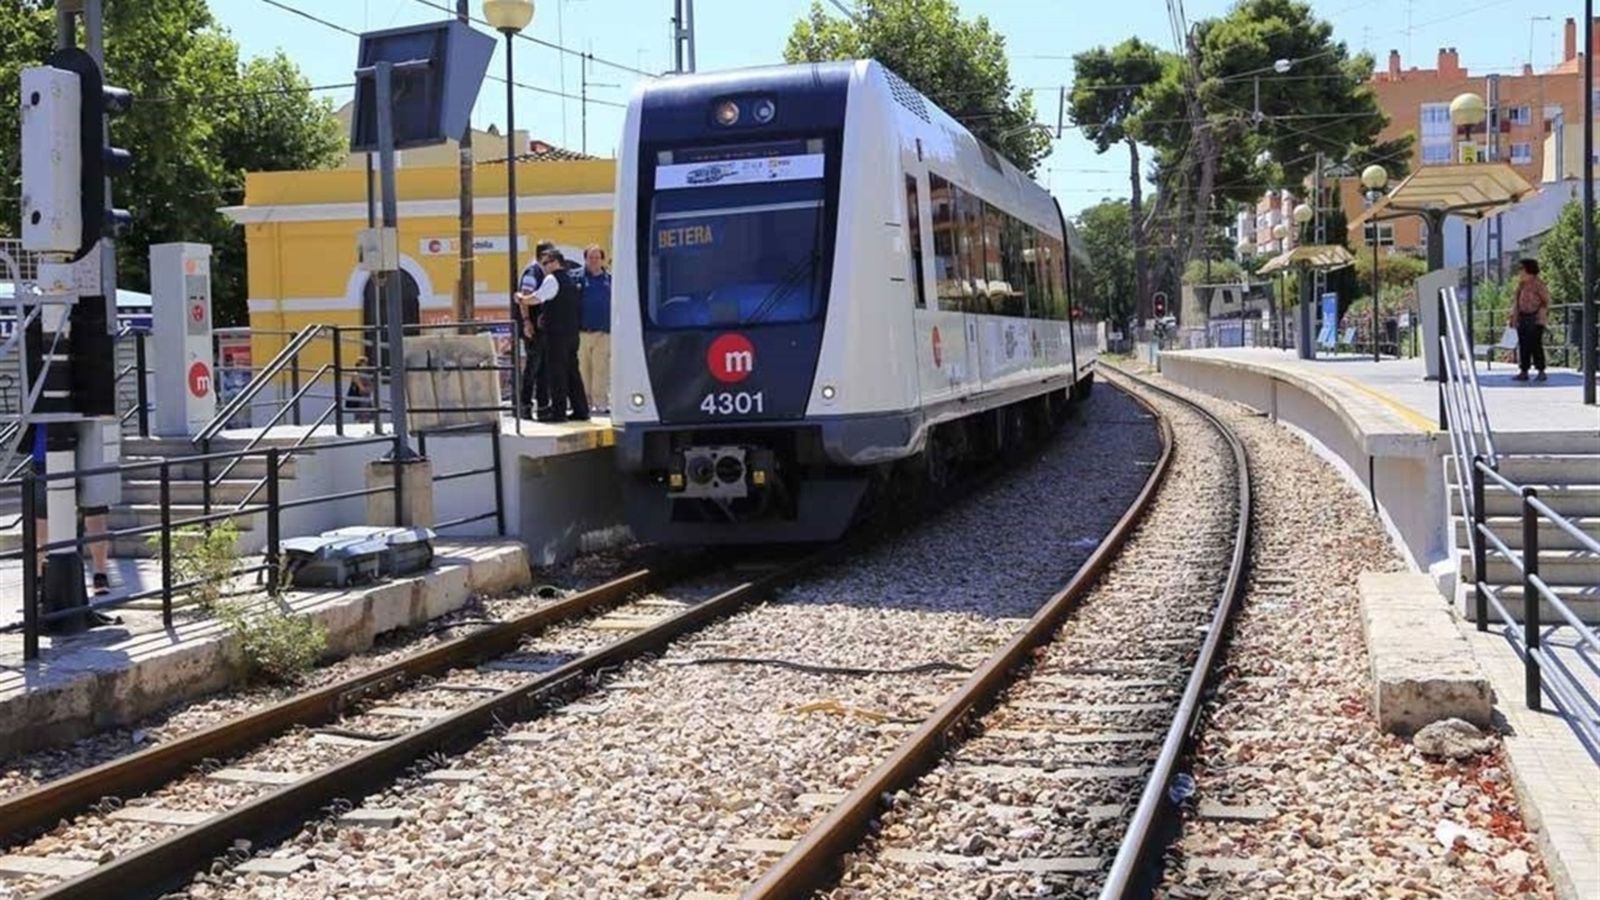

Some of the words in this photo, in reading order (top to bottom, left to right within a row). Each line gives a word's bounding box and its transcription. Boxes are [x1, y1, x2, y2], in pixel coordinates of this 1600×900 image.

[658, 225, 713, 249] BETERA
[725, 350, 753, 373] m
[700, 391, 763, 415] 4301
